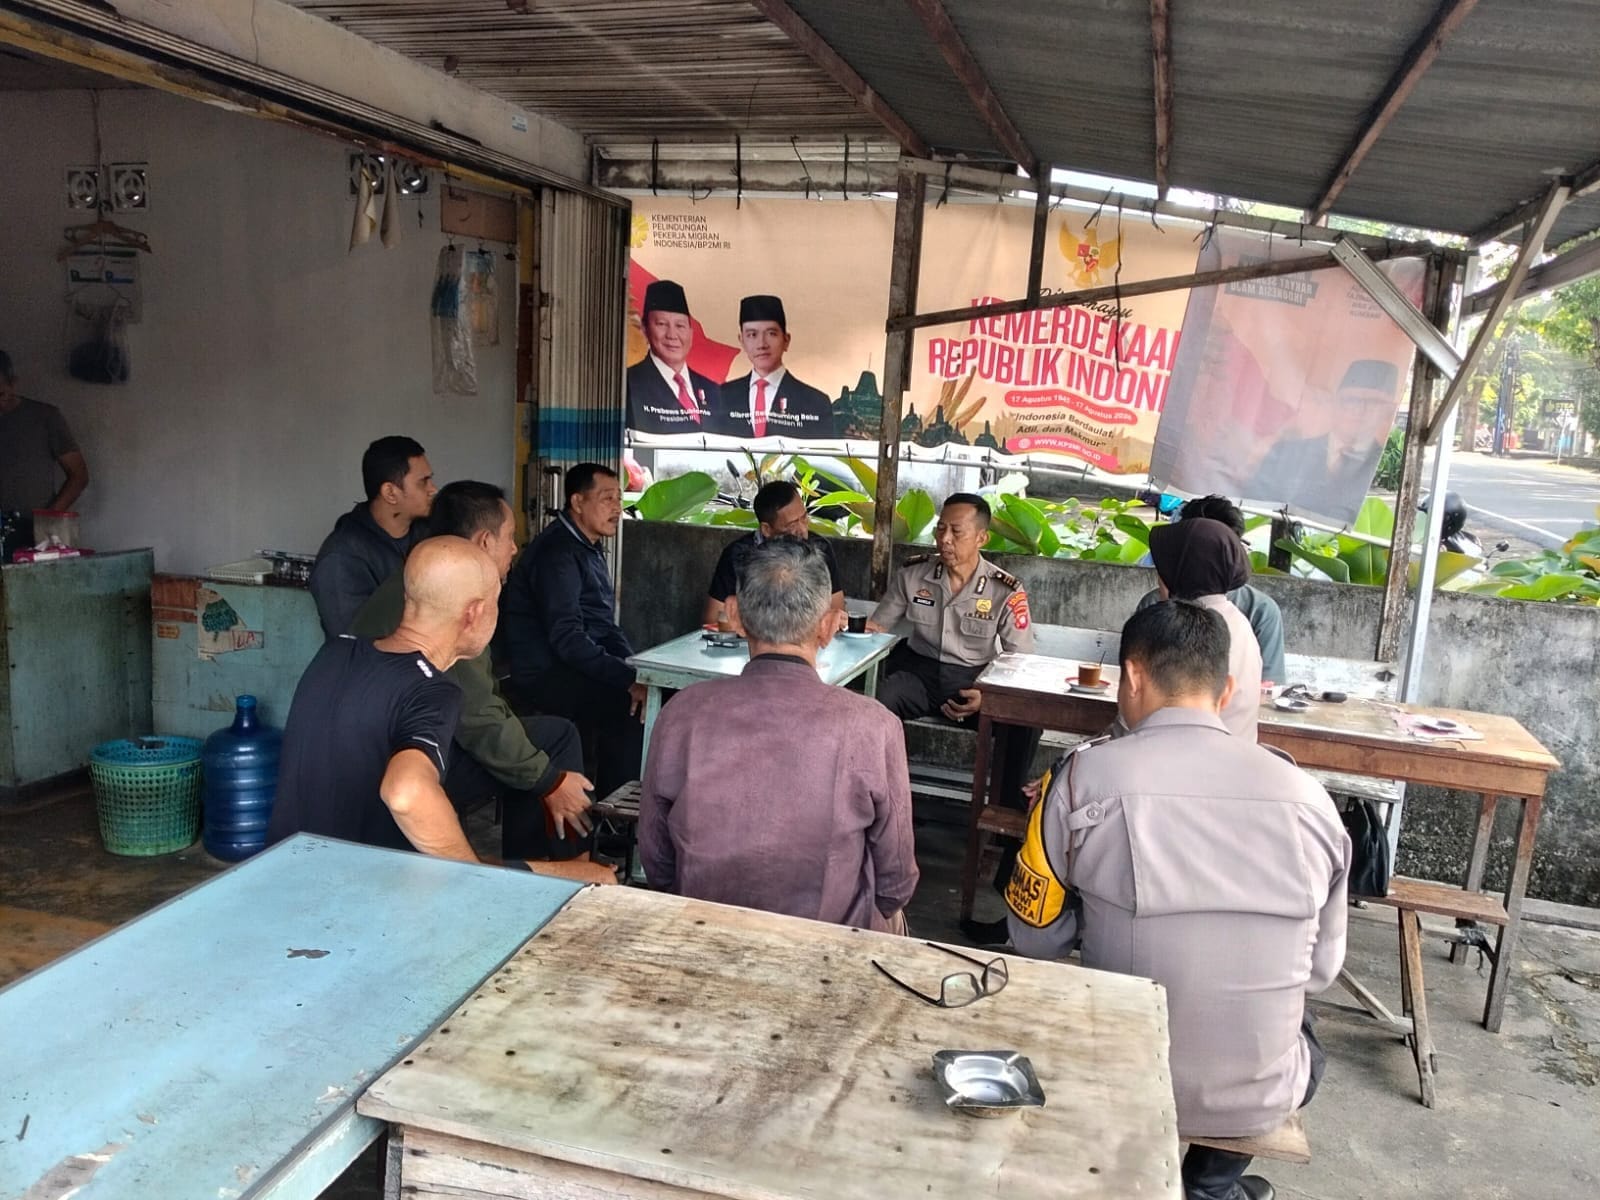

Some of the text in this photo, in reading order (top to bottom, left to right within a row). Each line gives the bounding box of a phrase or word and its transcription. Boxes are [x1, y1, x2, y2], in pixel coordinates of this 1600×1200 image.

[651, 214, 706, 223] KEMENTERIAN
[652, 222, 707, 231] PELINDUNGAN
[653, 231, 719, 240] PEKERJA MIGRAN
[929, 338, 1064, 386] REPUBLIK
[1016, 425, 1038, 435] Adil,
[1042, 425, 1061, 433] dan
